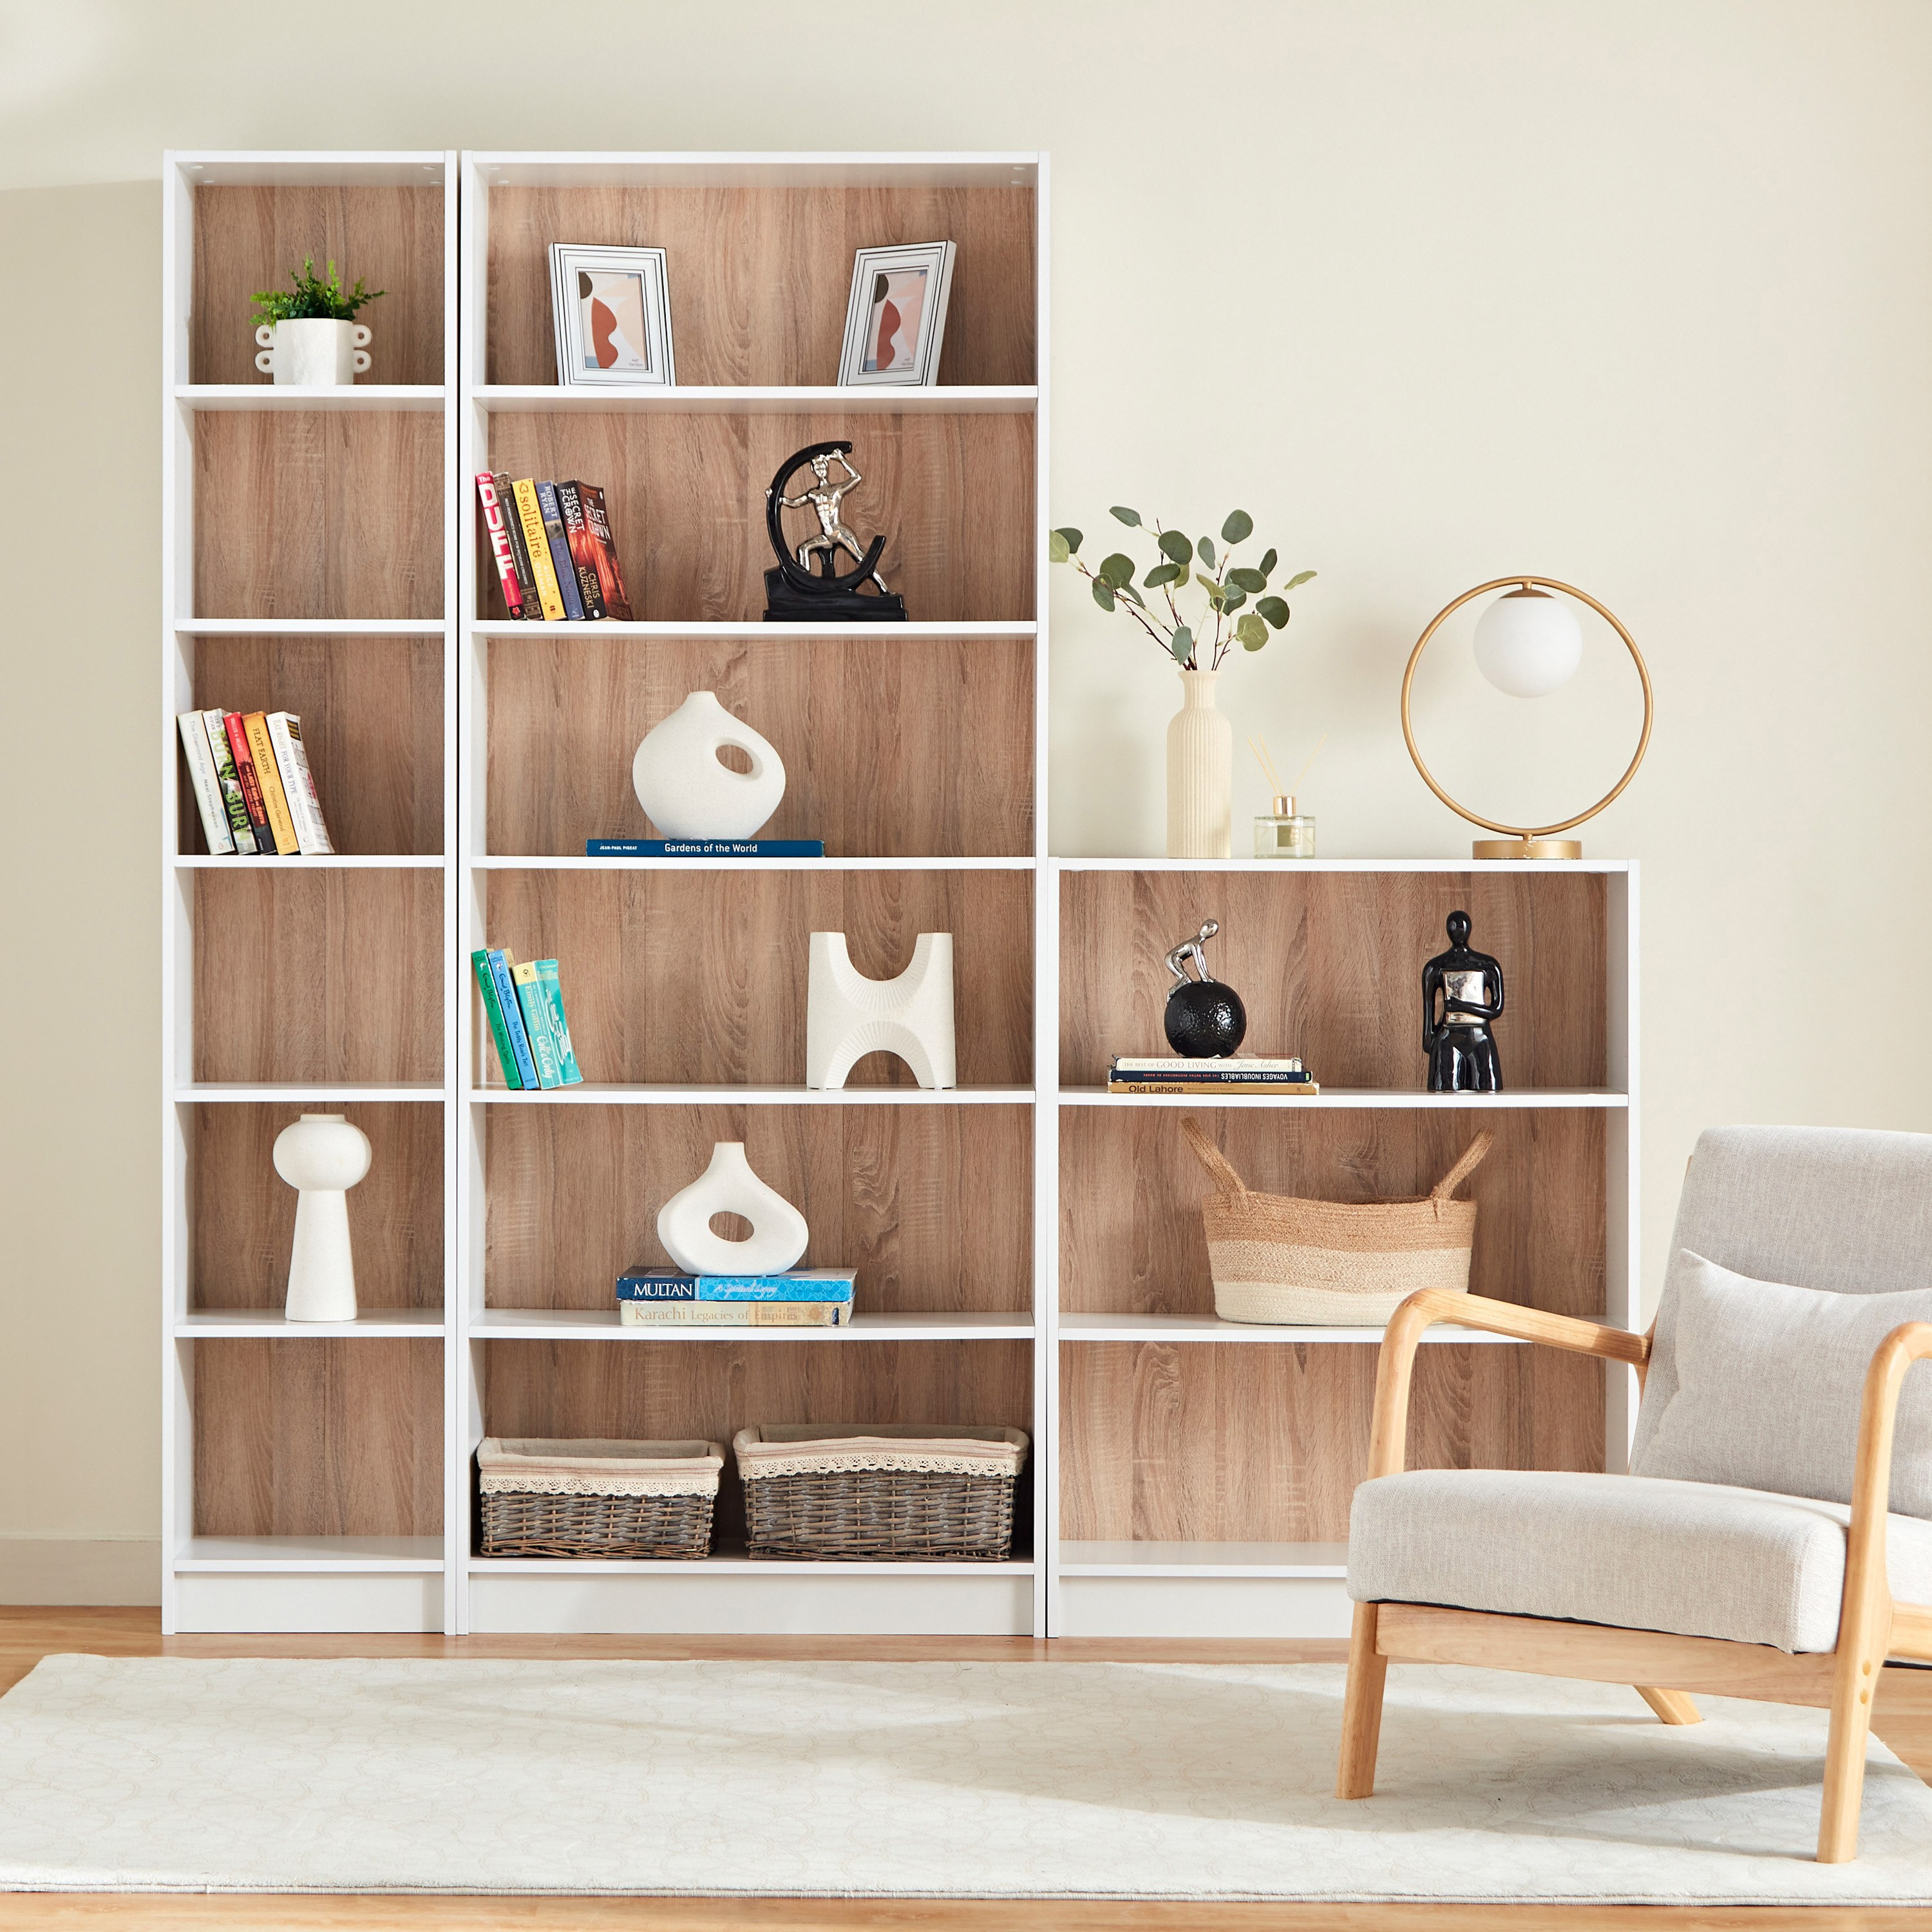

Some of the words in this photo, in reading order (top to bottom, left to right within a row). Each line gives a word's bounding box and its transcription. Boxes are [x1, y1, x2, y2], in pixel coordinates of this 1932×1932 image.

[540, 492, 550, 513] RYAN
[545, 486, 558, 517] ROBERT
[562, 496, 577, 533] CROWN
[569, 495, 585, 531] SECRET
[478, 483, 514, 580] DUFF
[520, 497, 542, 558] solitaire
[535, 562, 547, 596] OSEMAN
[544, 565, 554, 587] ALICE
[559, 560, 567, 578] Blue
[565, 581, 574, 605] Noon
[578, 566, 594, 608] KUZNESKI
[588, 573, 600, 598] CHRIS
[193, 733, 204, 761] Diamond
[253, 728, 263, 746] FLAT
[258, 748, 270, 774] EARTH
[281, 750, 289, 762] FOR
[284, 762, 293, 779] YOUR
[210, 730, 235, 780] BURN
[225, 792, 250, 841] BURN
[289, 779, 298, 795] TYPE
[251, 786, 260, 800] KIDS
[256, 806, 266, 824] EARTH
[269, 786, 278, 809] Christine
[275, 810, 285, 831] Garwood
[665, 843, 701, 852] Gardens
[703, 844, 714, 852] of
[715, 844, 730, 852] the
[732, 844, 757, 852] World
[482, 972, 491, 990] Enid
[499, 973, 507, 991] Enid
[503, 989, 513, 1010] Blyton
[486, 989, 496, 1009] Blyton
[541, 1057, 555, 1078] Only
[1233, 1060, 1255, 1070] Jane
[1255, 1060, 1279, 1068] Asher
[634, 1283, 693, 1296] MULTAN
[634, 1307, 686, 1320] Karachi
[691, 1310, 734, 1323] Legacies
[738, 1310, 750, 1320] of
[754, 1310, 798, 1323] Empires
